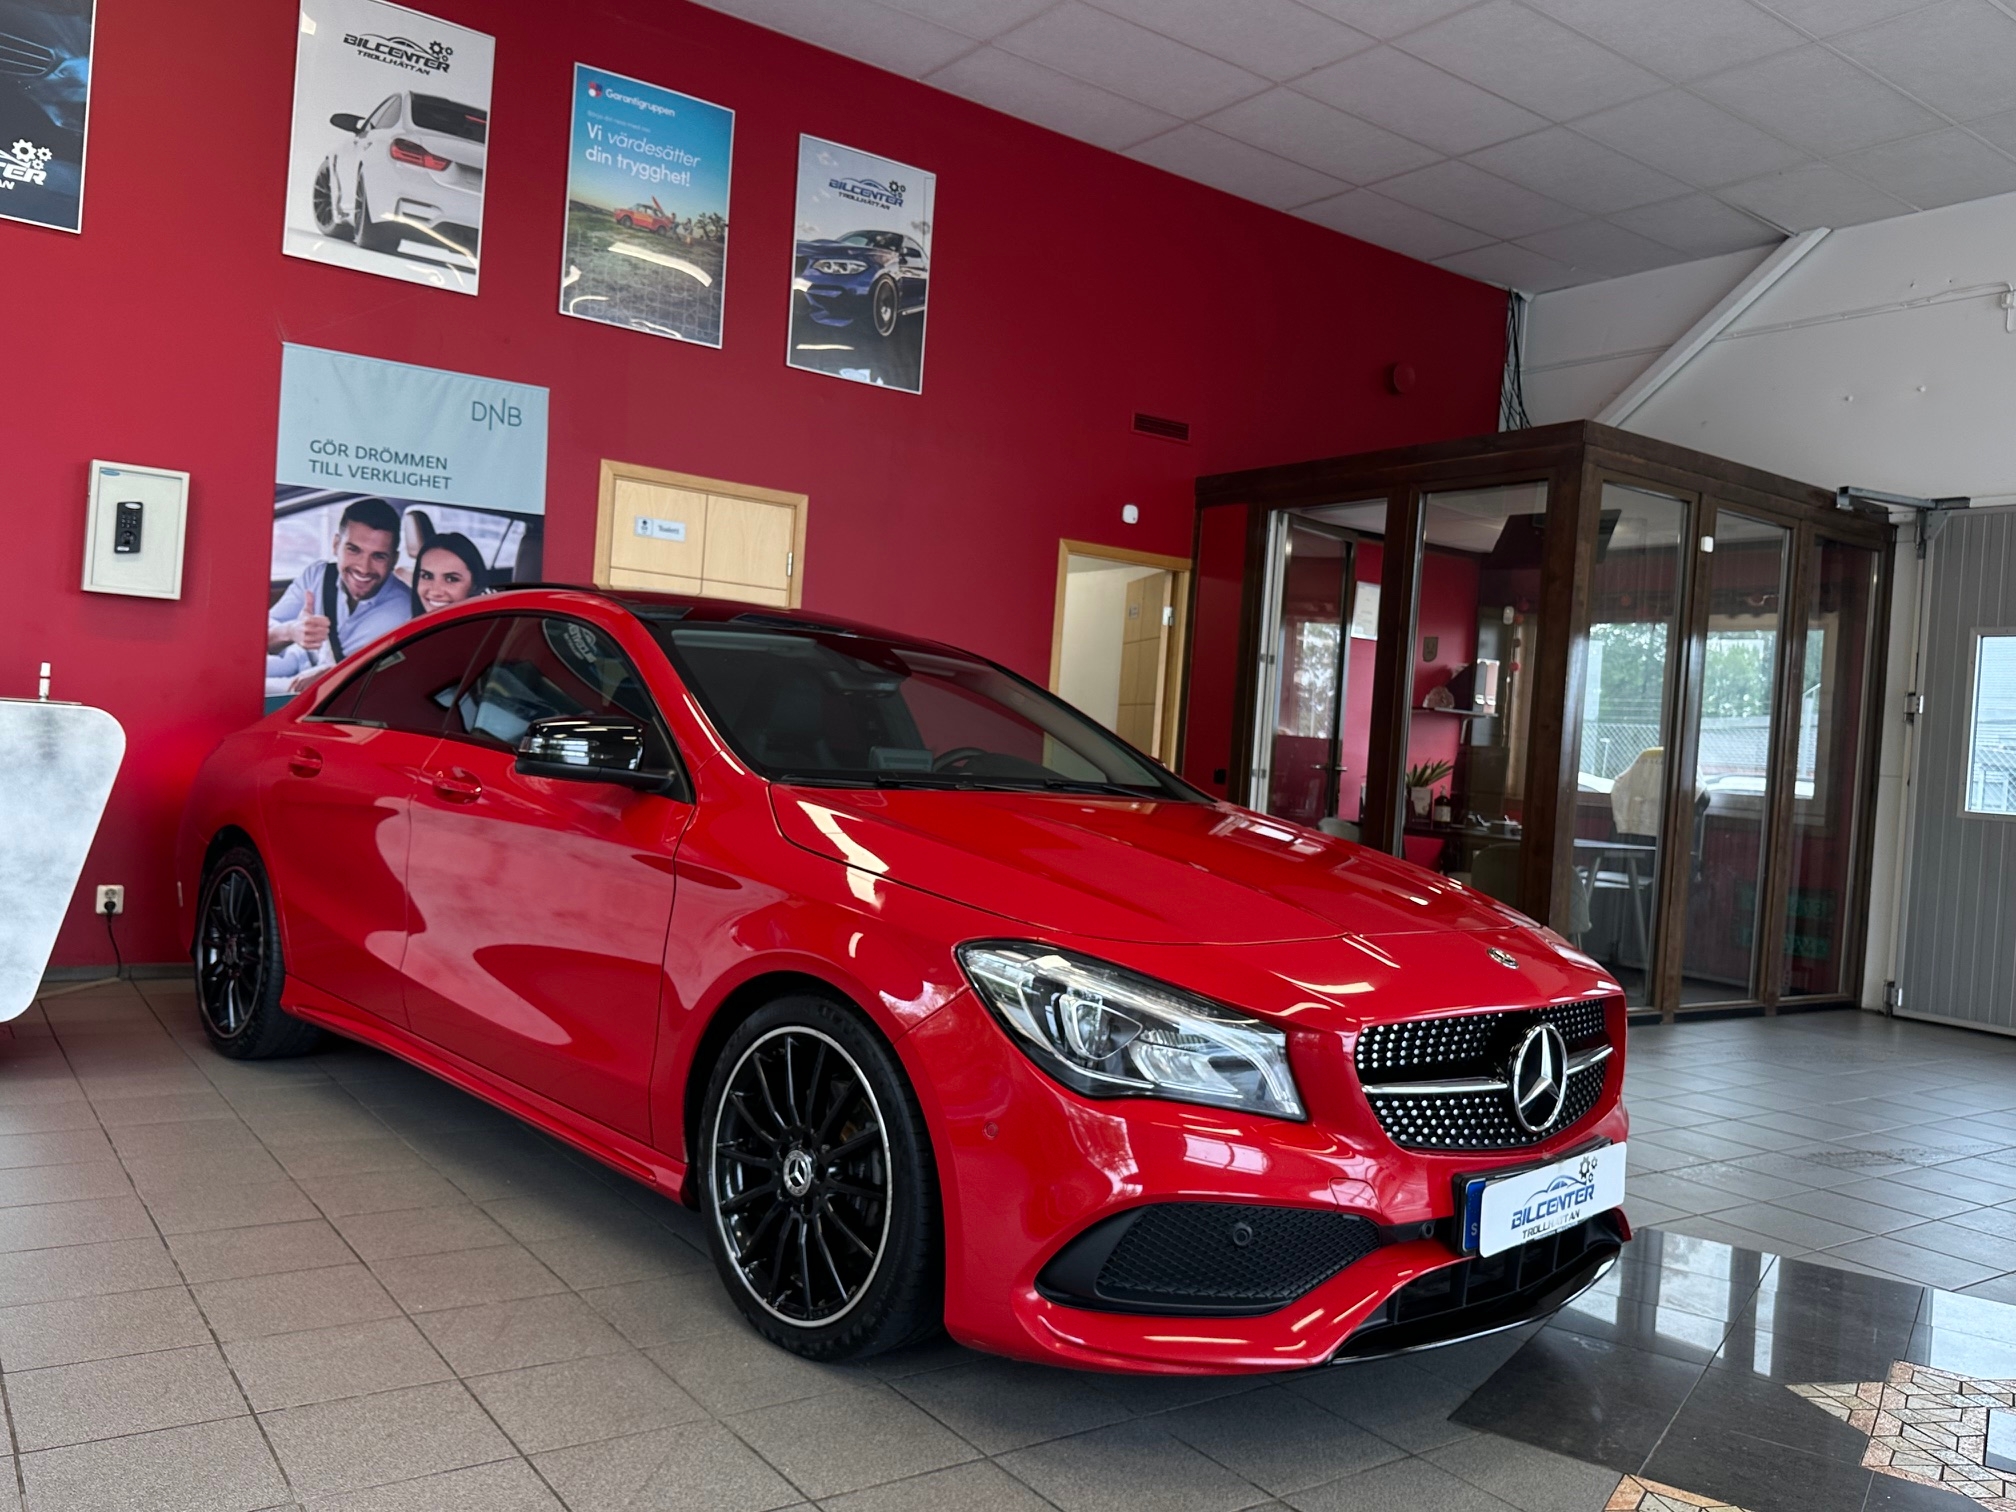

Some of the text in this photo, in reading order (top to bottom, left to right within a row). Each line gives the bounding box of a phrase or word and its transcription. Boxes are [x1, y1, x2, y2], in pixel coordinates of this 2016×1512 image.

[343, 33, 450, 73] BILCENTER
[605, 88, 676, 117] Garantigruppen
[587, 122, 701, 167] Vi värdesätter
[585, 145, 691, 187] din trygghet!
[828, 178, 904, 207] BILCENTER
[471, 398, 522, 431] DNB
[309, 438, 448, 471] GÖR DRÖMMEN
[308, 458, 452, 491] TILL VERKLIGHET
[1511, 1183, 1595, 1230] BILCENTER
[1471, 1222, 1478, 1236] S
